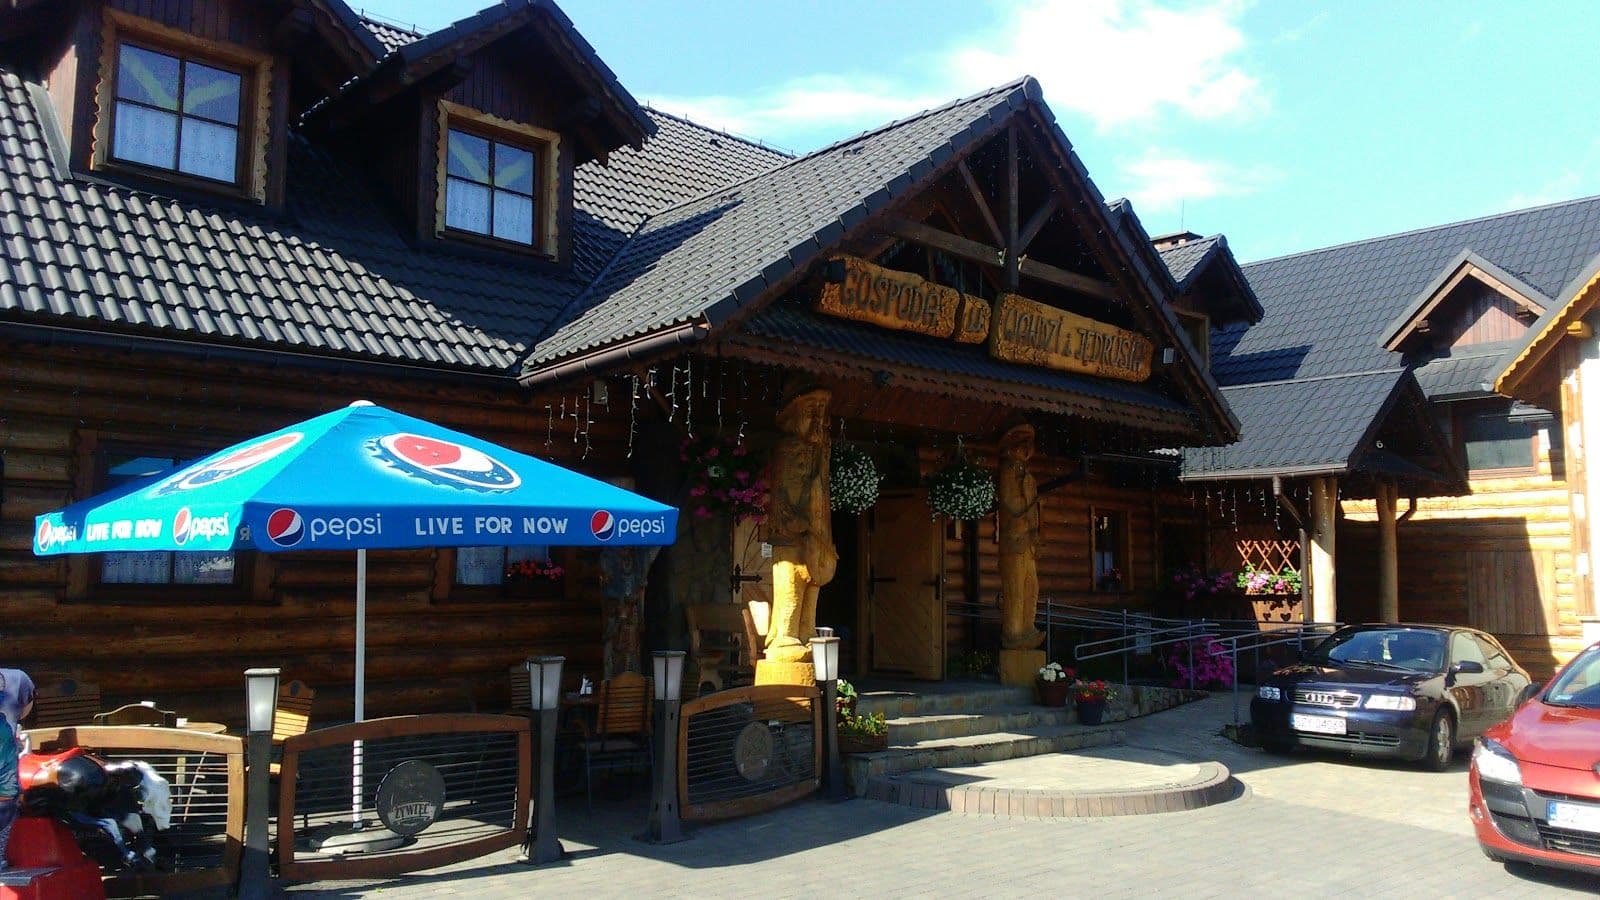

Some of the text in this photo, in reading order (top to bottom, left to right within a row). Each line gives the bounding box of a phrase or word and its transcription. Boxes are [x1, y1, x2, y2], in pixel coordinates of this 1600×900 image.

[841, 268, 940, 326] GOSPODA
[86, 522, 110, 542] LIVE
[112, 519, 133, 540] FOR
[135, 518, 162, 538] NOW
[190, 511, 230, 541] pepsi
[310, 513, 665, 541] pepsi LIVE FOR NOW pepsi
